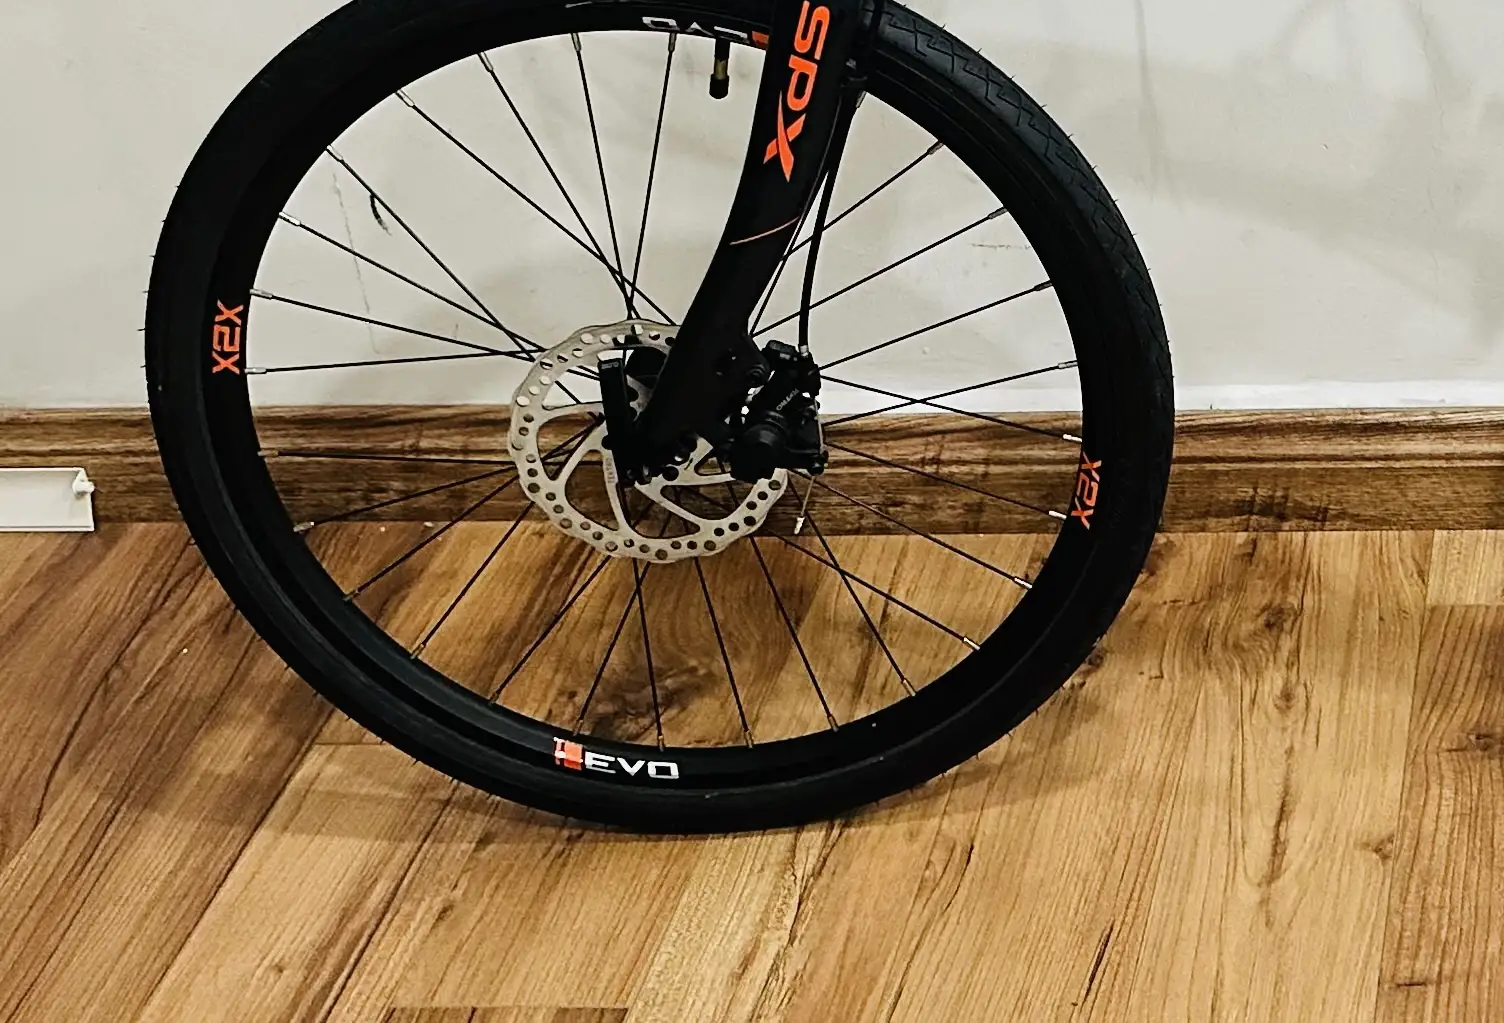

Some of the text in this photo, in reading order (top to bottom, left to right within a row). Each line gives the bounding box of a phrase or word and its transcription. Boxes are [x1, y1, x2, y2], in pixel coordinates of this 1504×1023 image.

[211, 298, 244, 375] X2X
[1071, 451, 1102, 531] X2X
[584, 751, 680, 780] EVO
